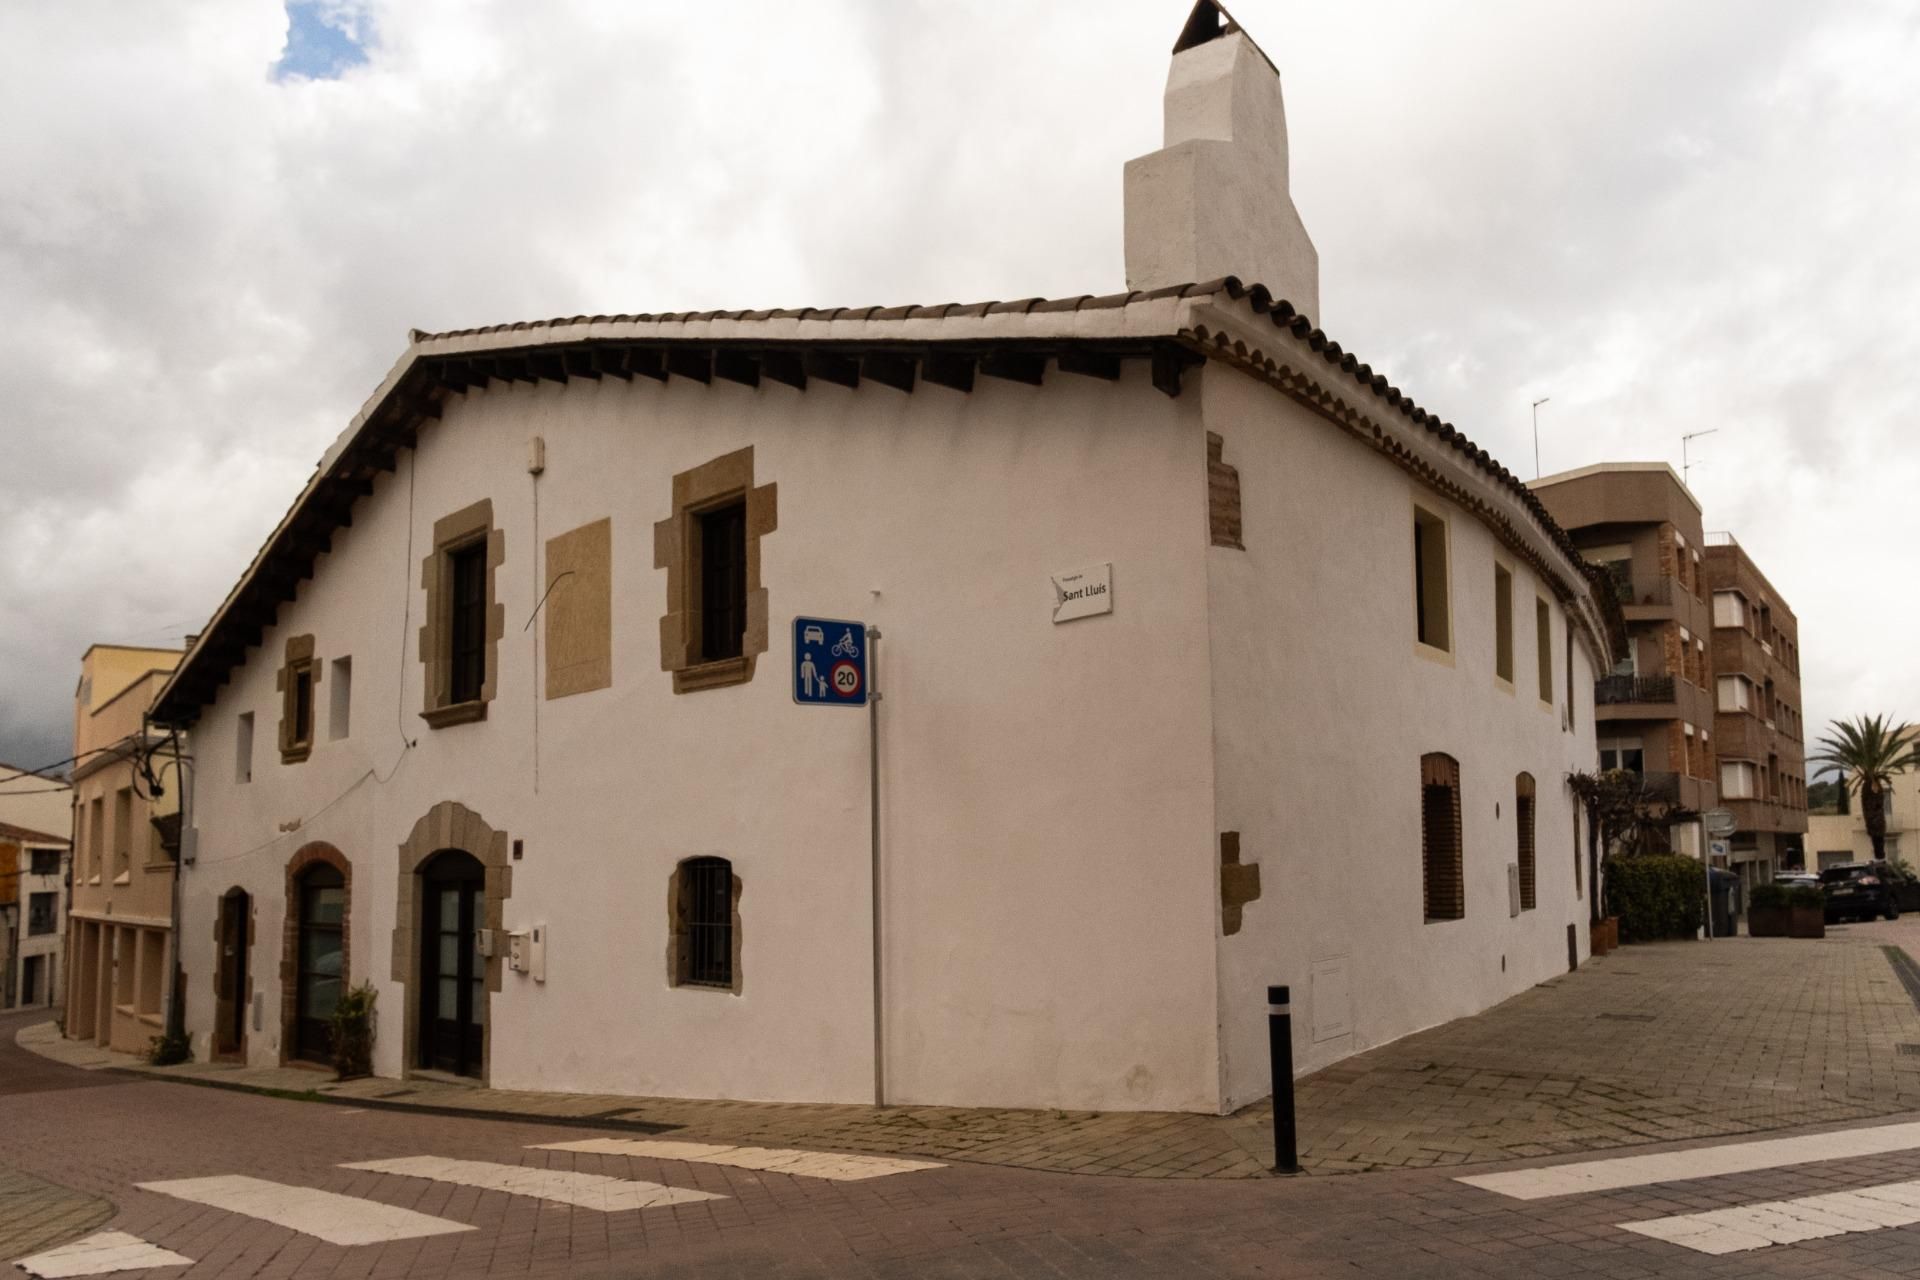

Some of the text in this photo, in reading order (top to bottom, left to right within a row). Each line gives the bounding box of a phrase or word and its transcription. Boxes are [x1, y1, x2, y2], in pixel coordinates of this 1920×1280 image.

[1063, 583, 1106, 602] Sant Lluís
[837, 671, 855, 686] 20
